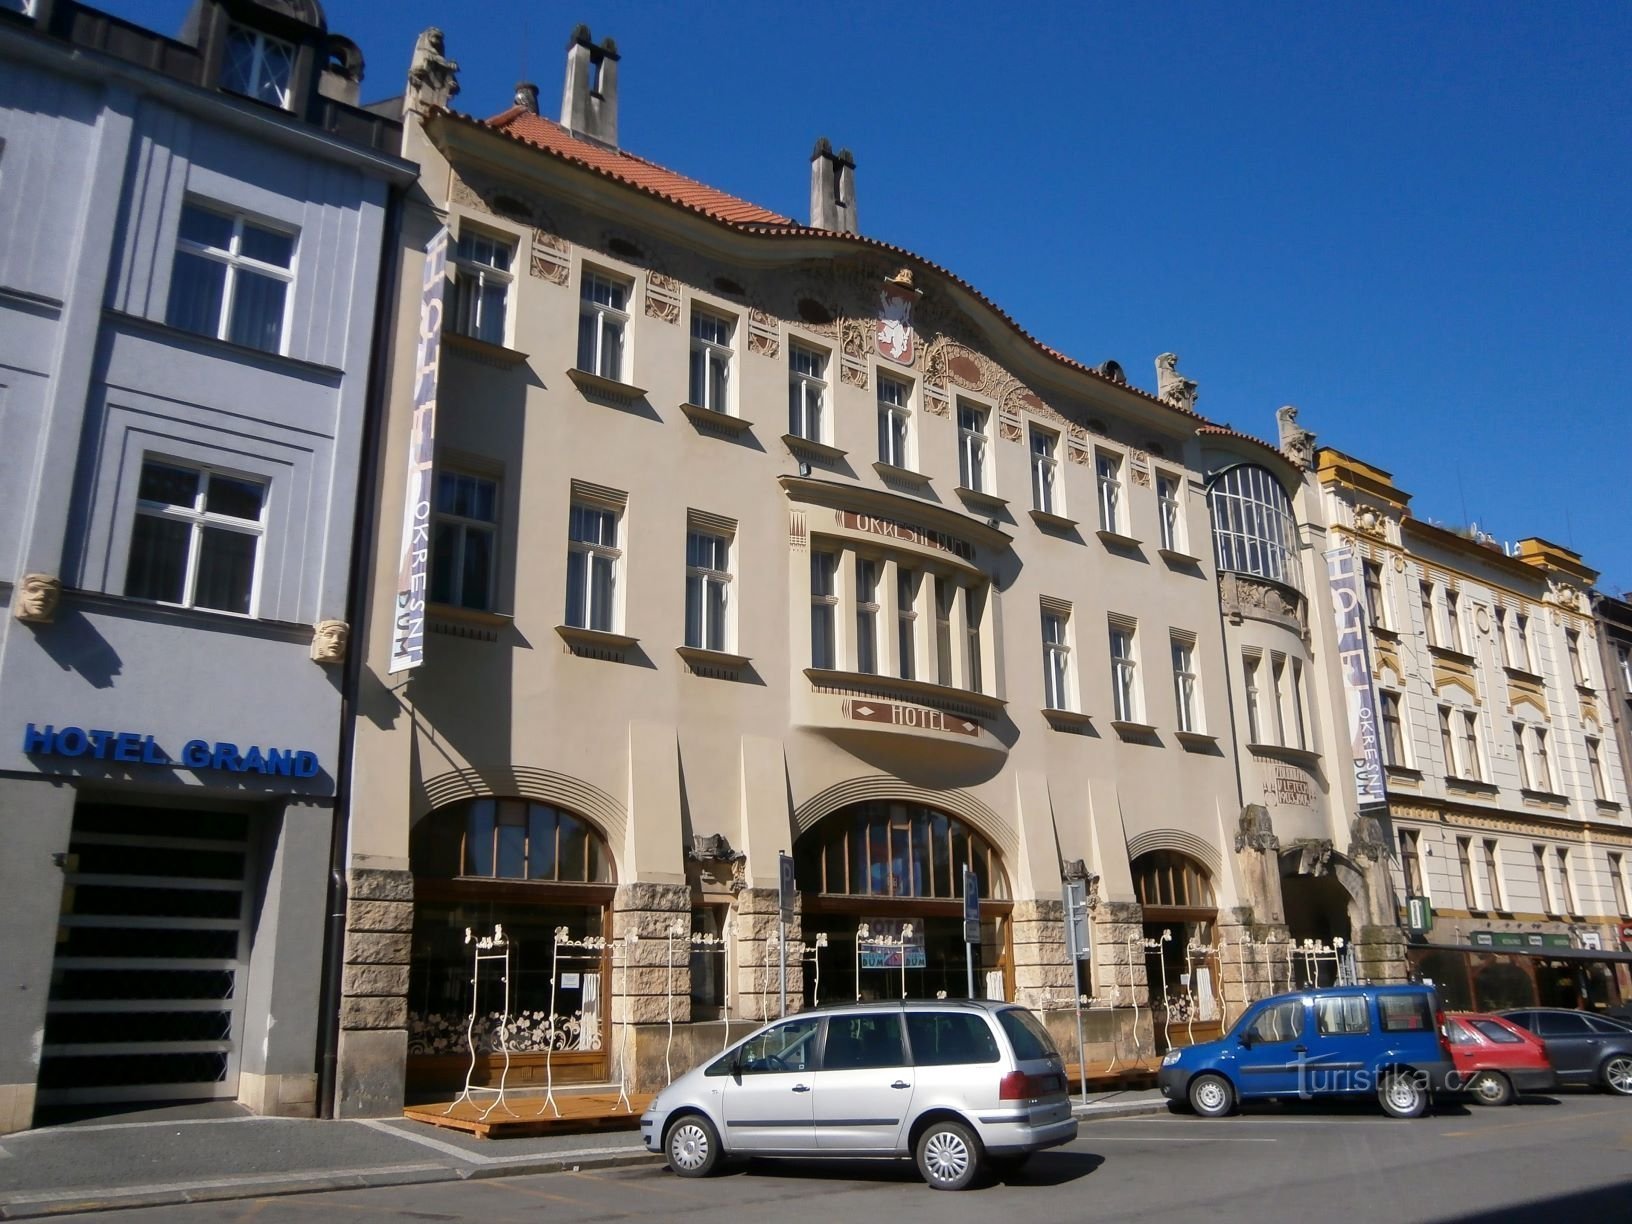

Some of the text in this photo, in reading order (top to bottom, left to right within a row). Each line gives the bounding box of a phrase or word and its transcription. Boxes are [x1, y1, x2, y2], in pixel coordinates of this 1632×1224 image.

[1328, 555, 1369, 690] HOTEL
[891, 704, 950, 731] HOTEL
[24, 723, 319, 778] HOTEL GRAND
[783, 863, 791, 891] P
